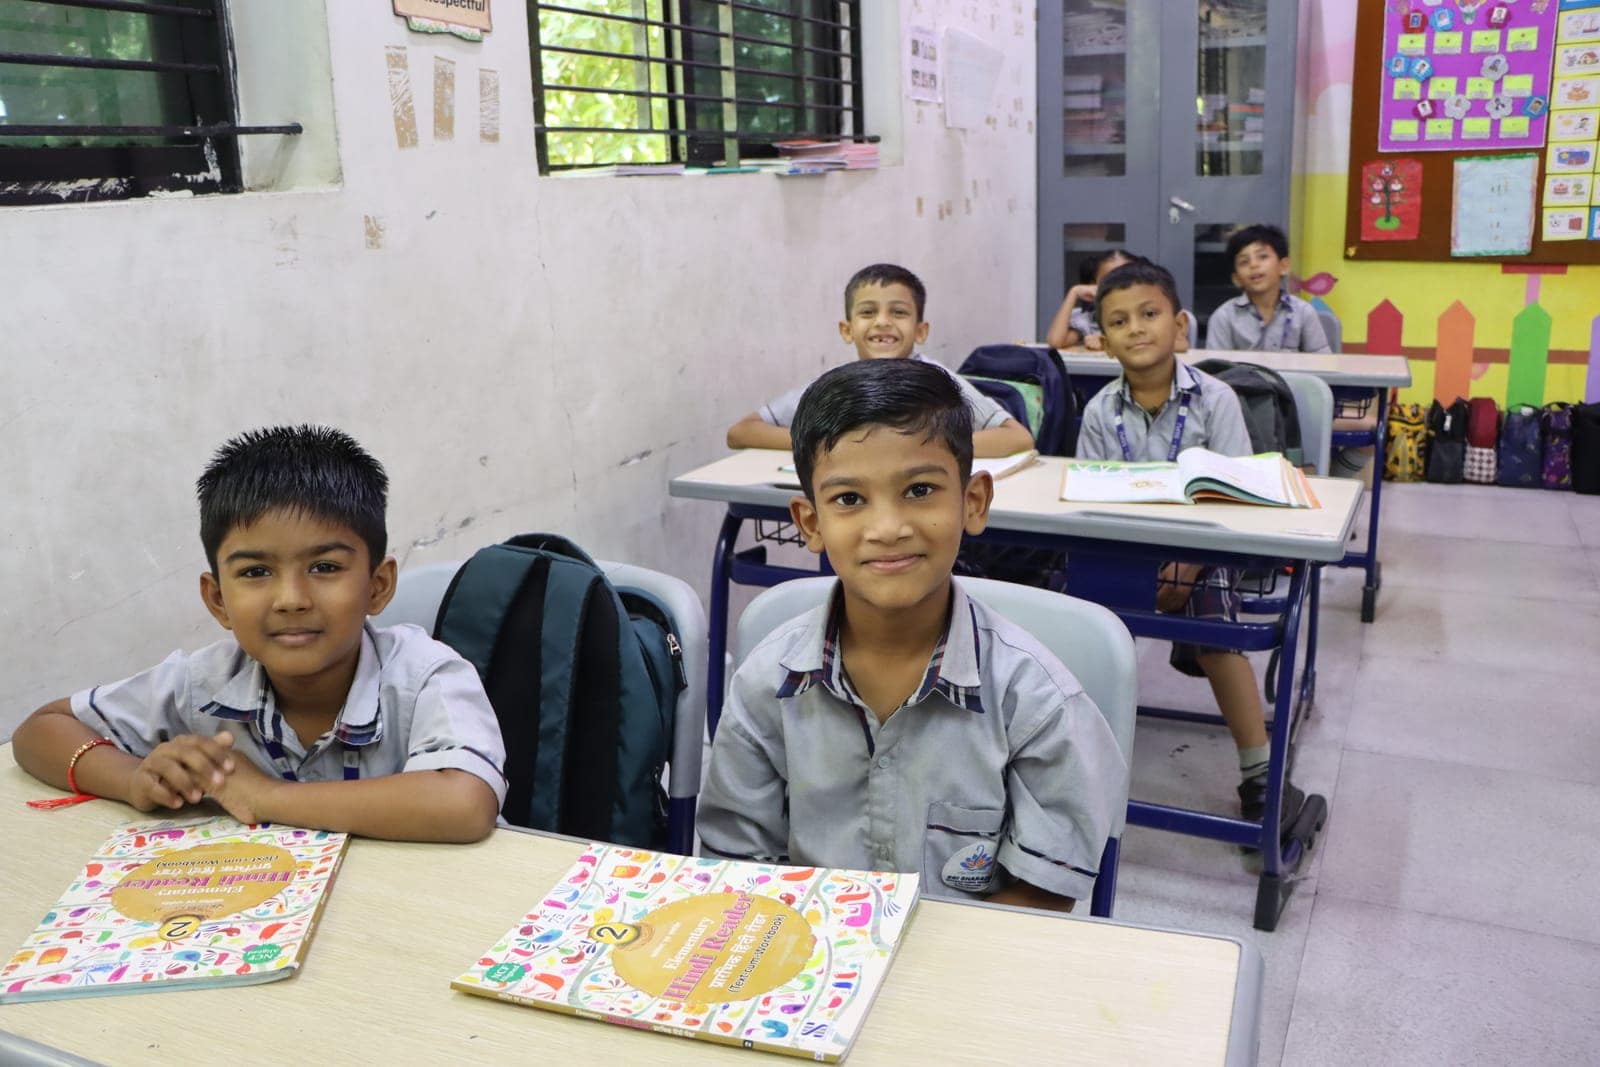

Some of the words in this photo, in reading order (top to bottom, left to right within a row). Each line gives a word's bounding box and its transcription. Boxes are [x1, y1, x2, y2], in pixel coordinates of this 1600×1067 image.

[424, 0, 485, 12] spectful
[123, 876, 211, 889] Reader
[219, 871, 291, 886] Hindi
[154, 885, 245, 897] Elementary
[166, 921, 193, 937] 2
[596, 926, 628, 940] 2
[662, 916, 715, 970] Elementary
[662, 953, 717, 1000] Hindi
[700, 892, 754, 952] Reader
